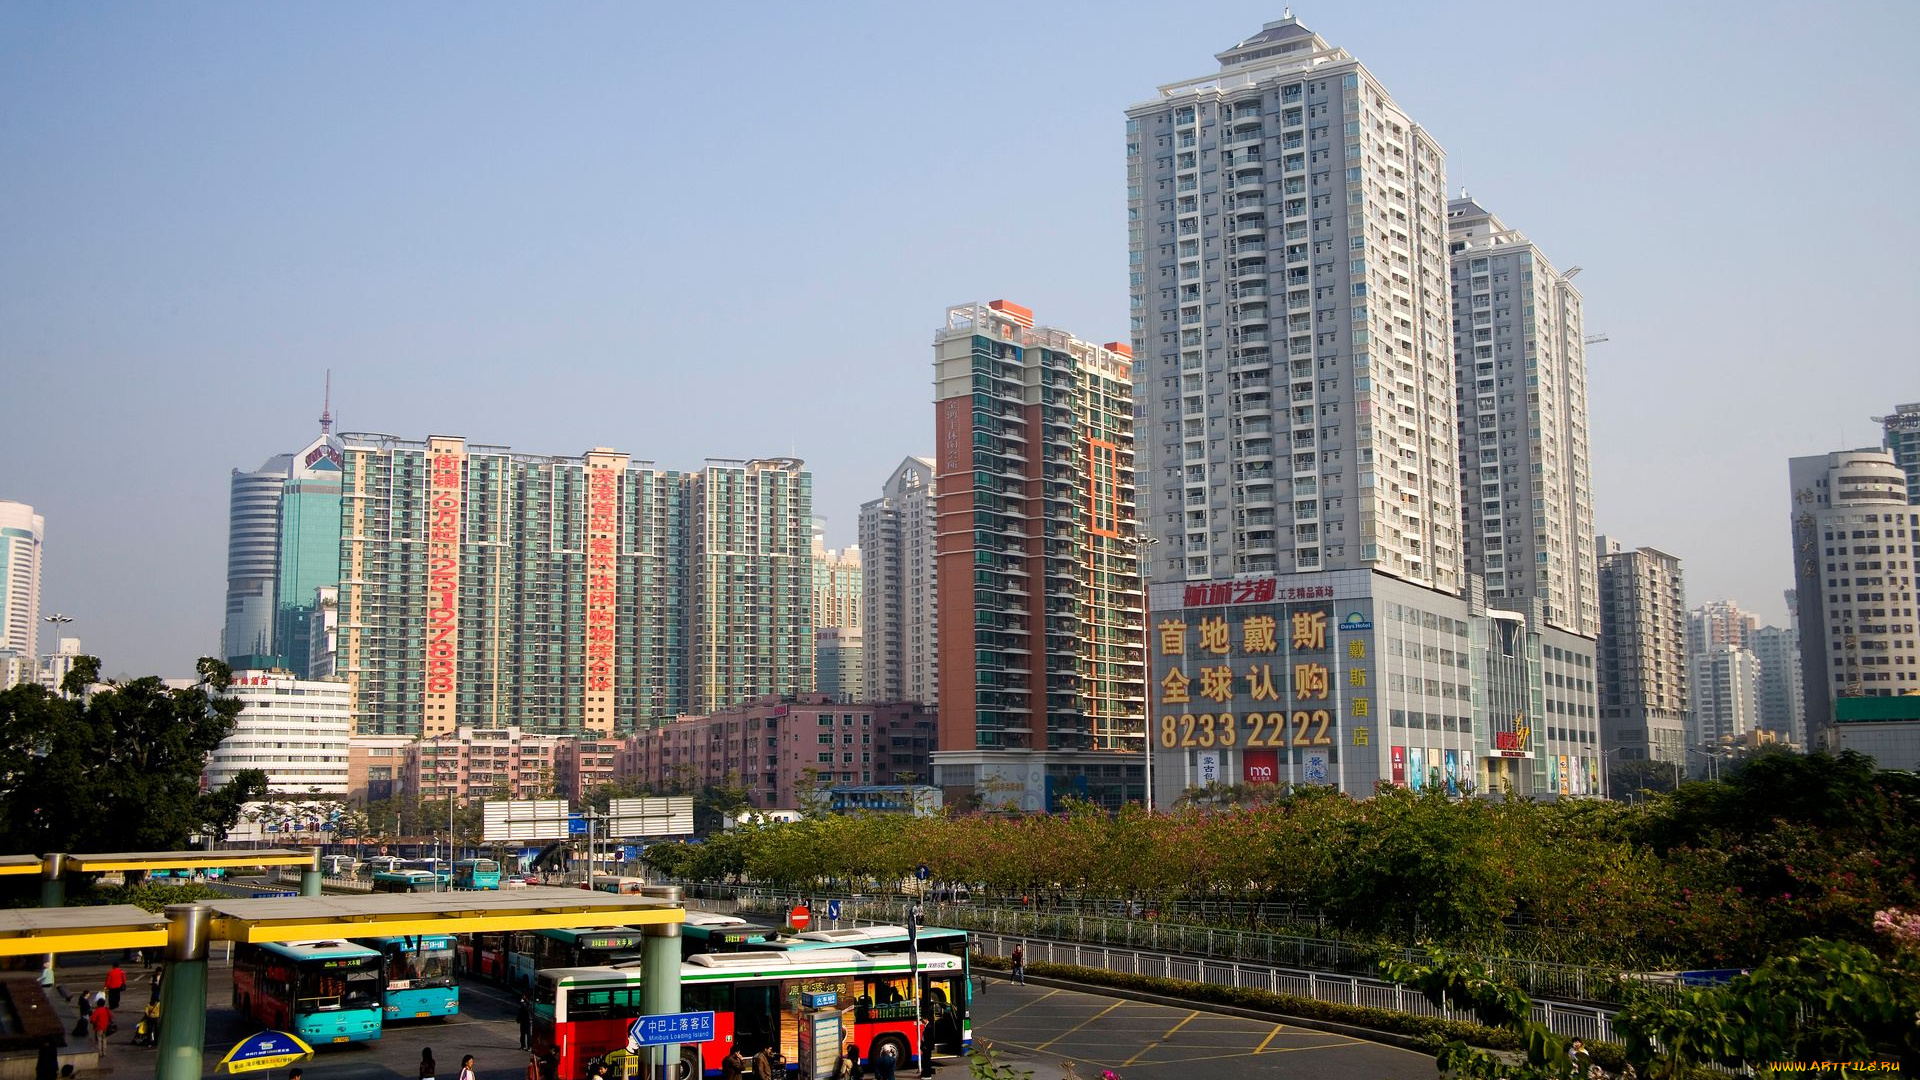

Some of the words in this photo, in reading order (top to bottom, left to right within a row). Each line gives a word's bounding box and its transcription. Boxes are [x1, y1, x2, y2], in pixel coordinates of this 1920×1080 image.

[433, 454, 460, 488] 街铺
[591, 469, 616, 532] 深港首站
[1158, 610, 1327, 655] 首地戴斯
[1160, 662, 1328, 704] 全球认购
[1348, 639, 1369, 747] 戴斯酒店
[648, 1016, 710, 1033] 中巴上落客区
[670, 1032, 692, 1040] Loading
